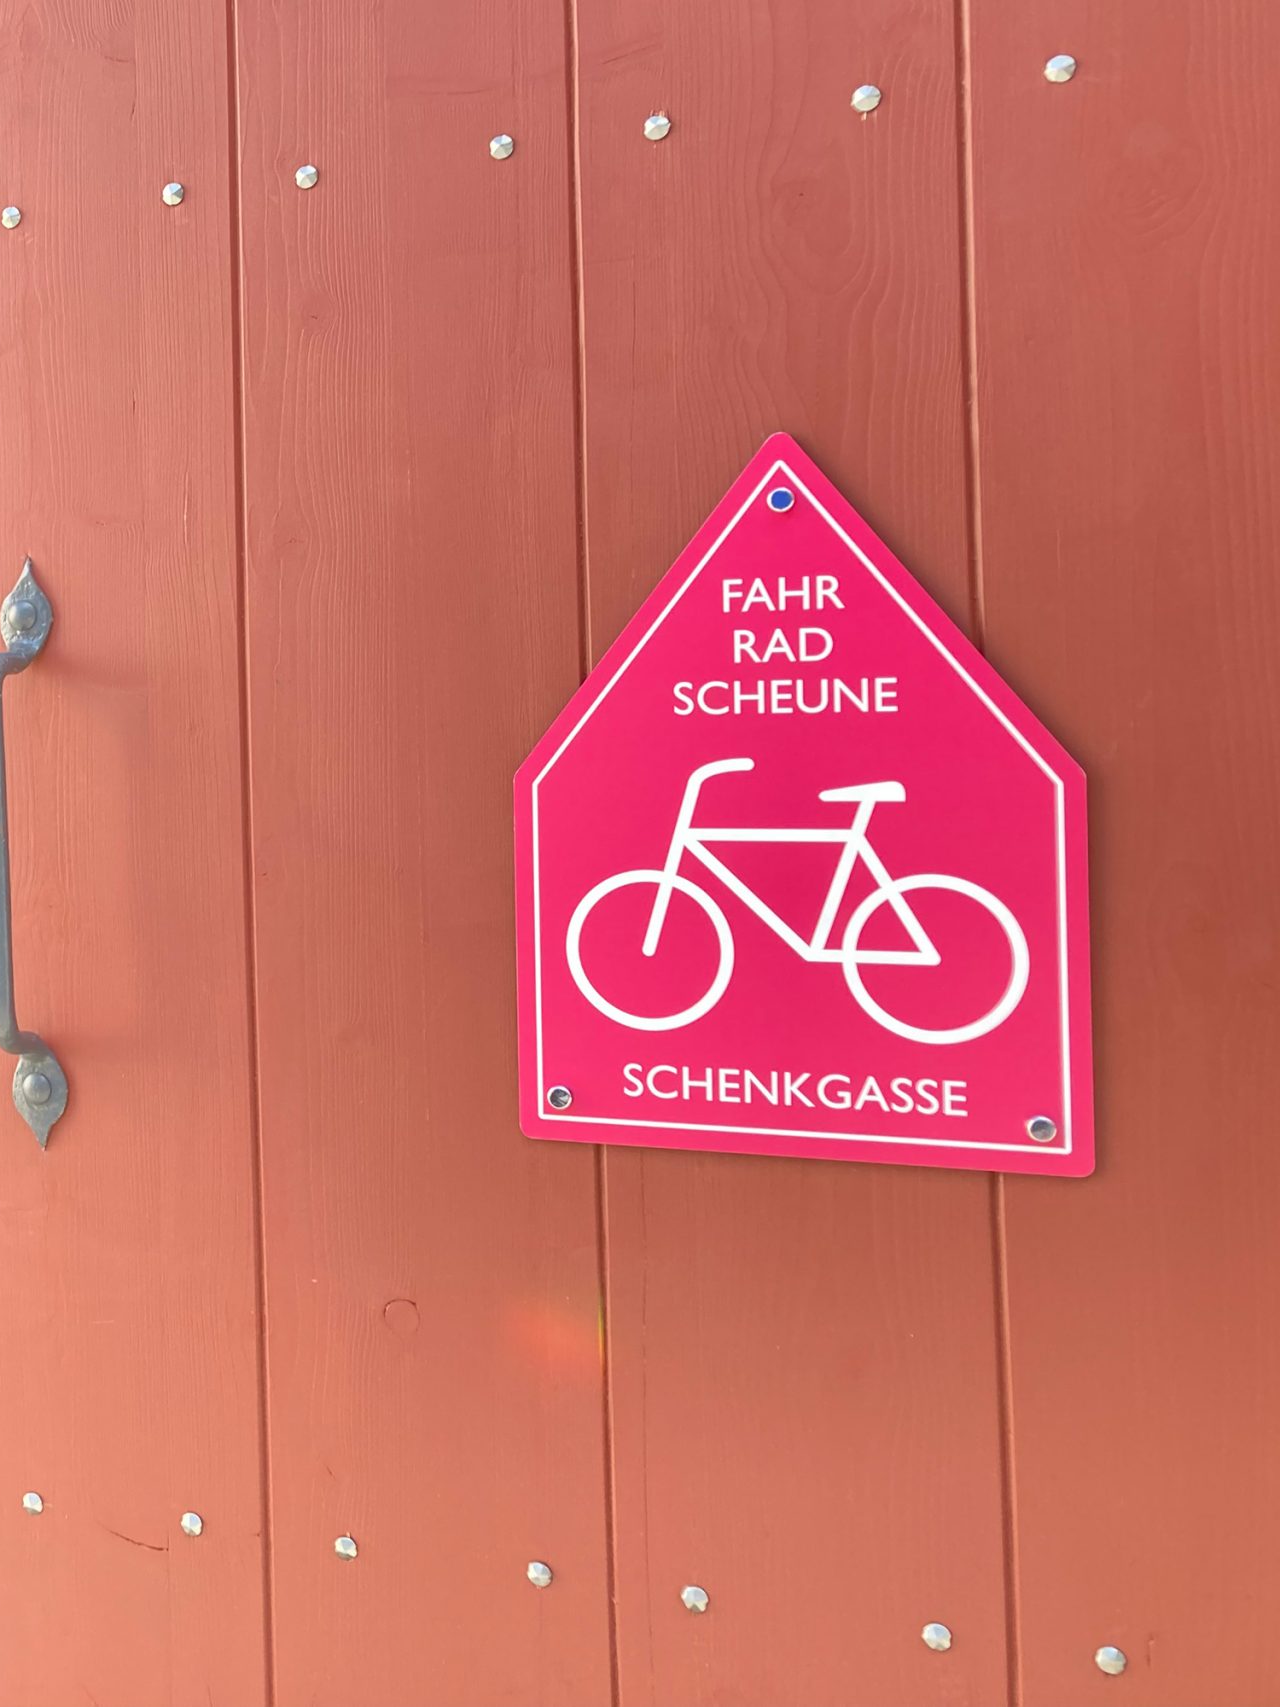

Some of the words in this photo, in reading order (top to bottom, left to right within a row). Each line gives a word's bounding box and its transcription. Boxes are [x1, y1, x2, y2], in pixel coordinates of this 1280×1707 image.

[721, 575, 846, 613] FAHR
[732, 627, 834, 664] RAD
[672, 677, 899, 716] SCHEUNE
[622, 1063, 969, 1117] SCHENKGASSE
